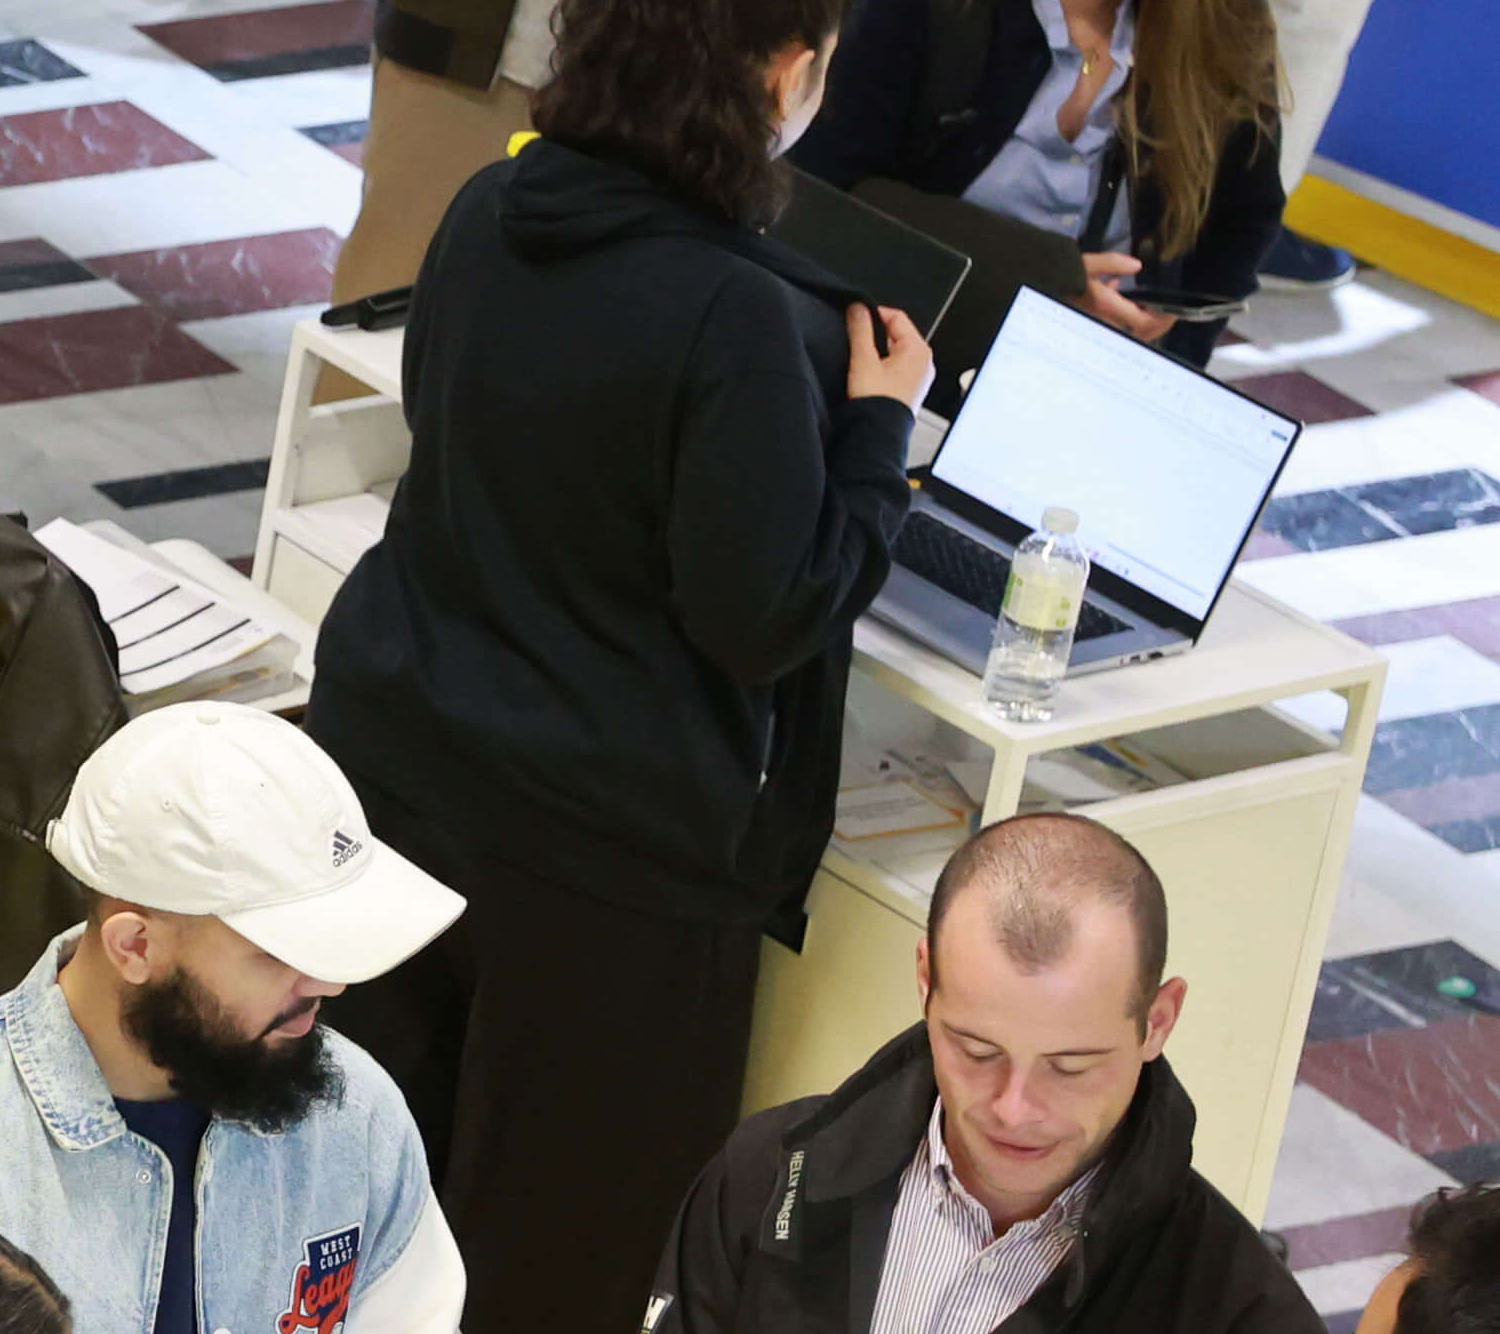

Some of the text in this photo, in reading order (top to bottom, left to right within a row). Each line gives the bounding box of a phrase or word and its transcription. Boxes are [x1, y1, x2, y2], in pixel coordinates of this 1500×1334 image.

[332, 840, 363, 868] adidas
[788, 1150, 805, 1188] HELLY
[320, 1234, 351, 1256] WEST
[319, 1248, 353, 1271] COAST
